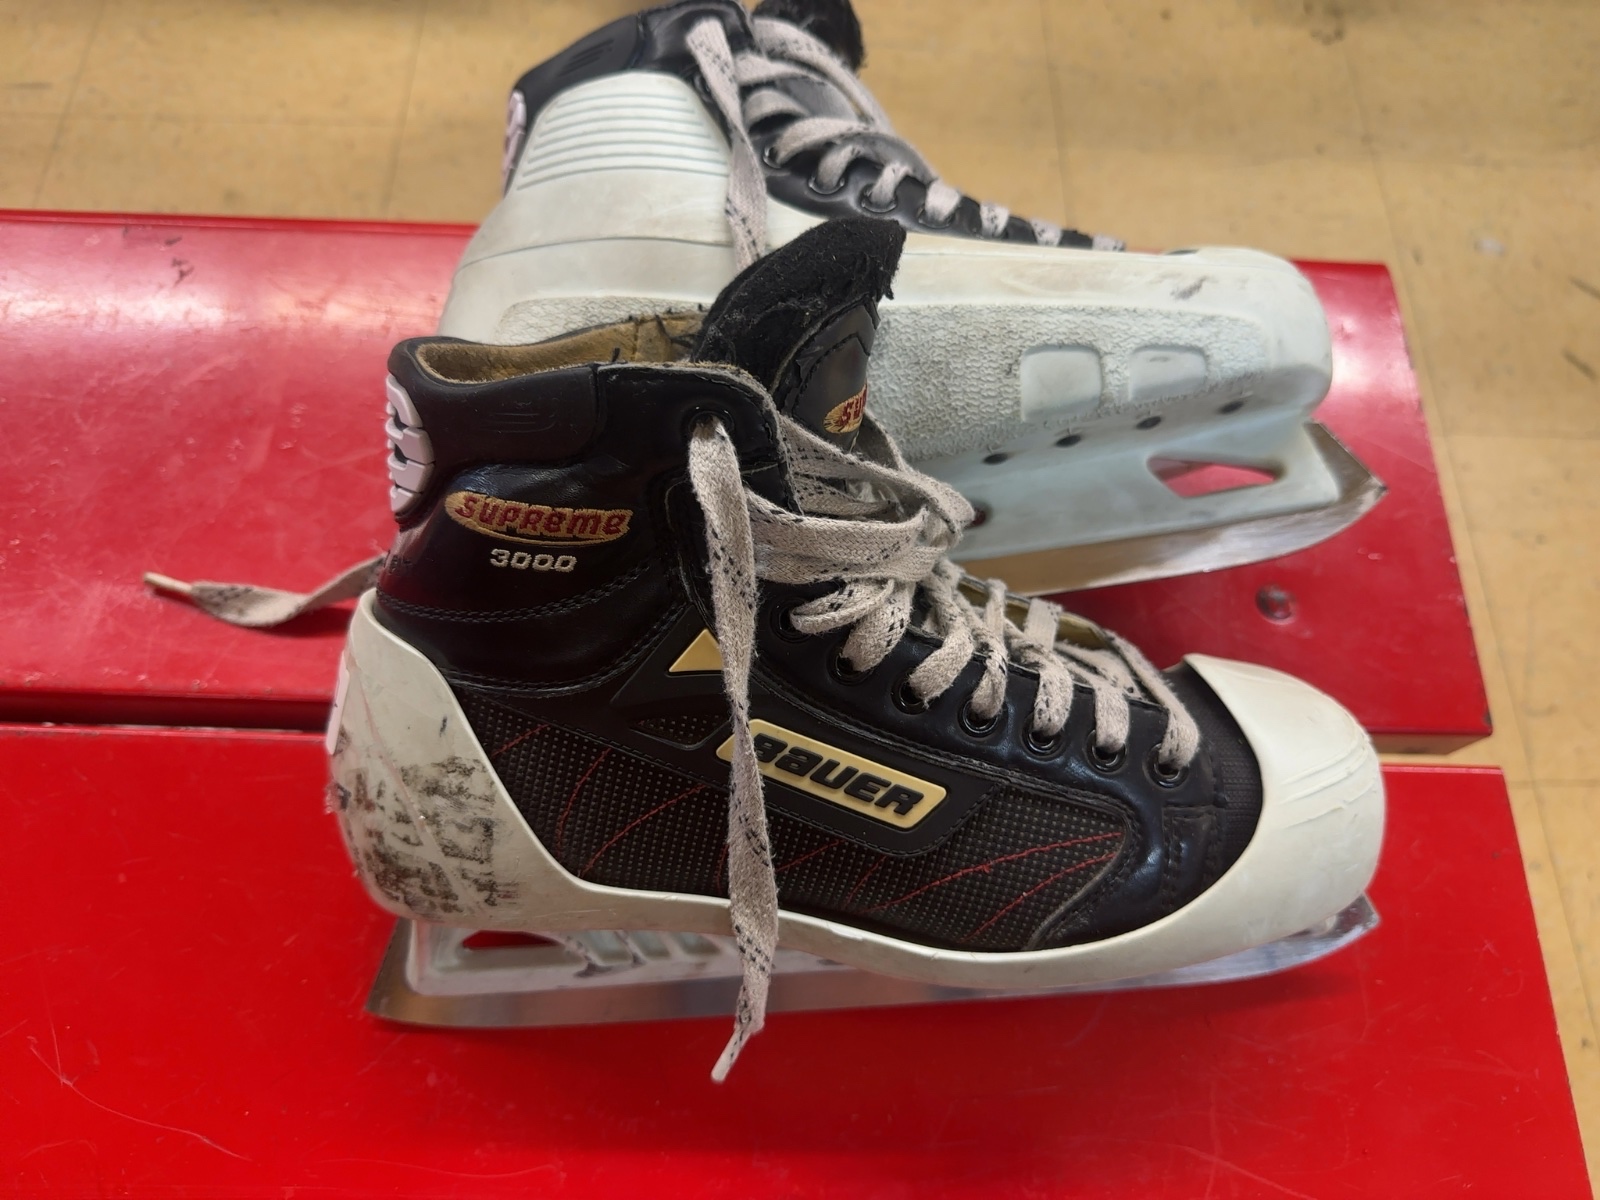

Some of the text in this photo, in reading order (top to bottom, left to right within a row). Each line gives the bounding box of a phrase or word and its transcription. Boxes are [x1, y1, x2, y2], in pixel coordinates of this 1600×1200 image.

[454, 495, 628, 536] SUPREME
[489, 548, 578, 573] 3000
[752, 732, 925, 817] BAUER
